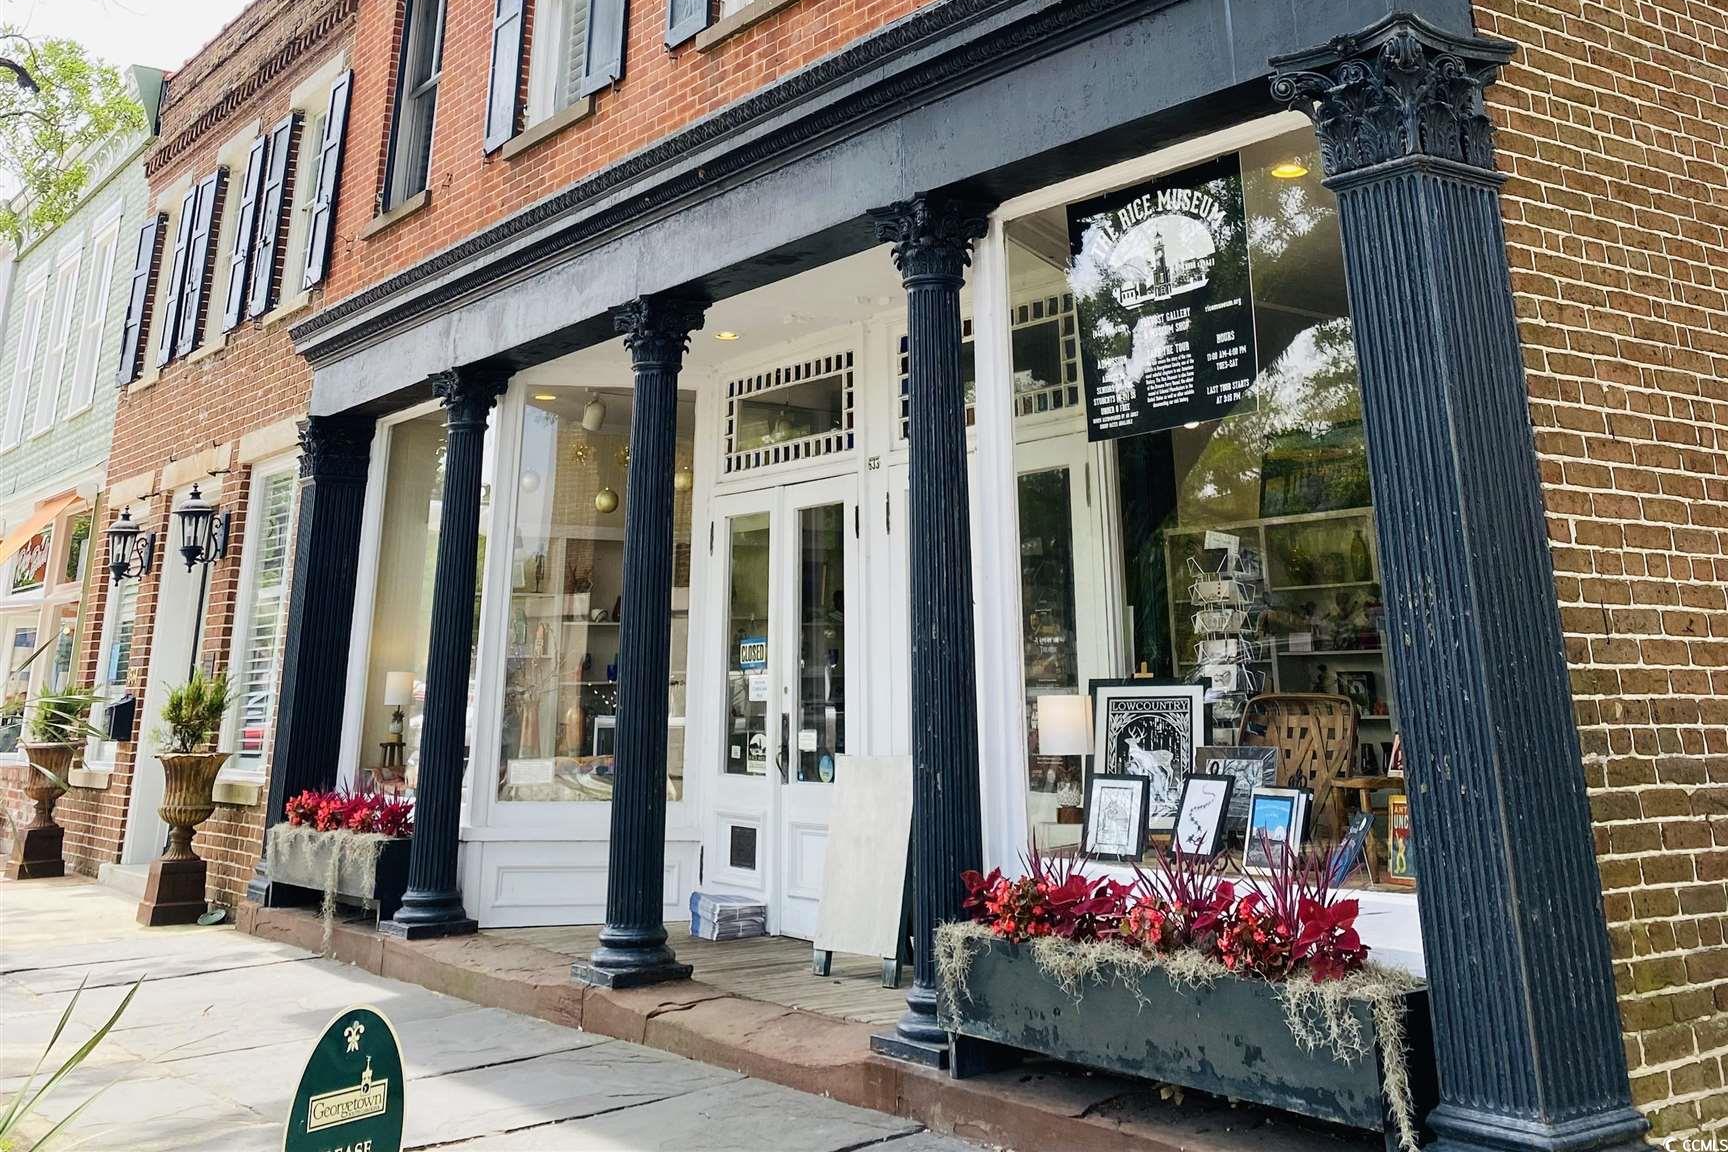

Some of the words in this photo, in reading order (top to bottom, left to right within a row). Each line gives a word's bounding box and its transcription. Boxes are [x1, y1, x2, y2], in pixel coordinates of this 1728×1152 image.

[1118, 194, 1153, 230] RICE
[1156, 188, 1228, 228] MUSEUM
[1205, 298, 1241, 312] ricemuseum.org
[1165, 307, 1190, 321] GALLERY
[1216, 330, 1235, 344] HOURS
[1175, 340, 1189, 353] TOUR
[1239, 345, 1247, 354] PM
[1216, 358, 1238, 371] TUES-SAT
[1207, 385, 1219, 395] LAST
[1220, 382, 1231, 393] TOUR
[1232, 378, 1250, 390] STARTS
[1093, 394, 1115, 406] STUDENTS
[1216, 395, 1223, 405] AT
[1233, 391, 1241, 401] PM
[742, 644, 765, 663] CLOSED
[1112, 700, 1188, 711] LOWCOUNTRY
[313, 1094, 382, 1120] Georgetown
